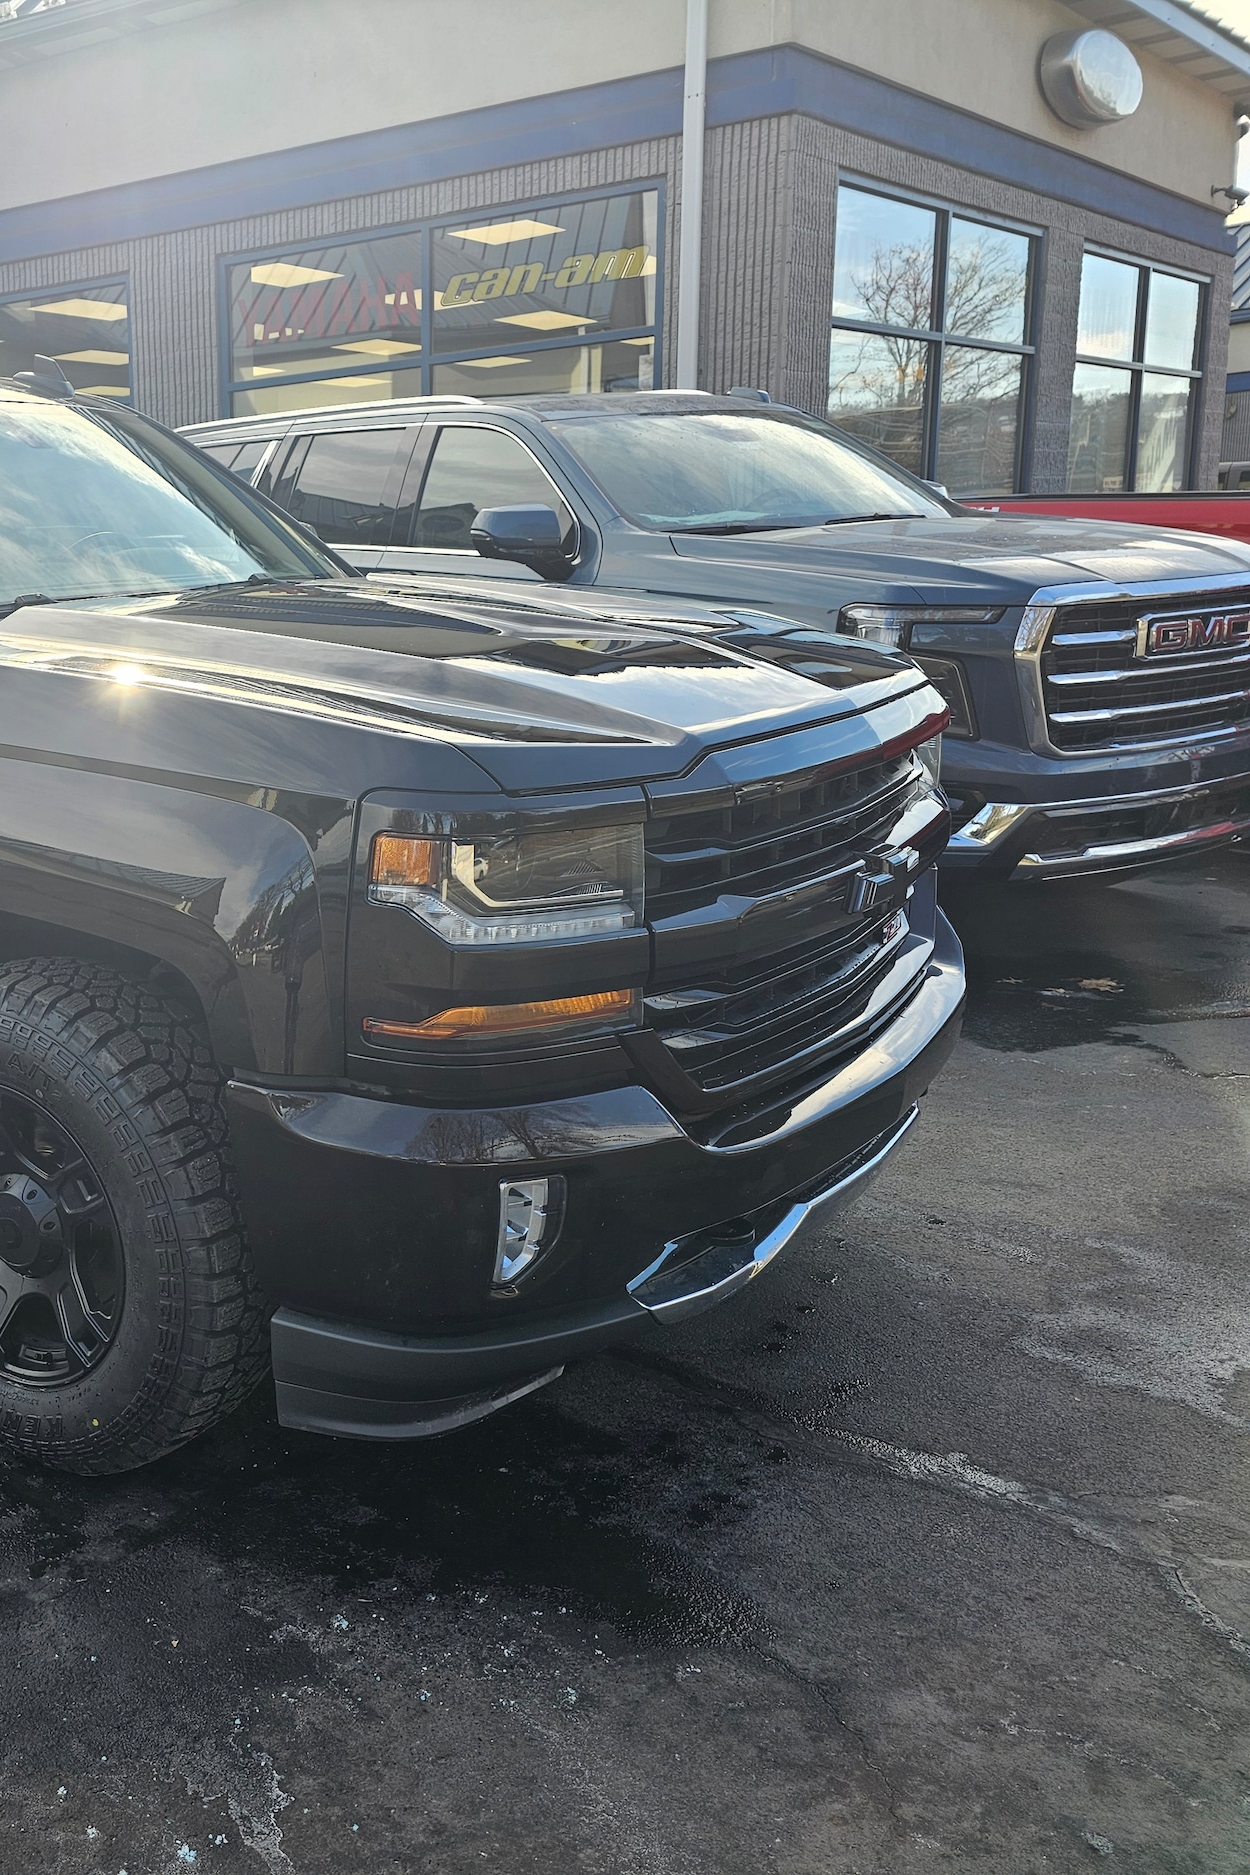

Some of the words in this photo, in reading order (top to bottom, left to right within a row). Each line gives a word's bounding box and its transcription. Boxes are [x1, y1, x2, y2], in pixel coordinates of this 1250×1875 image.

[440, 245, 650, 307] can-am
[237, 271, 421, 348] YAMAHA
[1150, 613, 1250, 652] GMC
